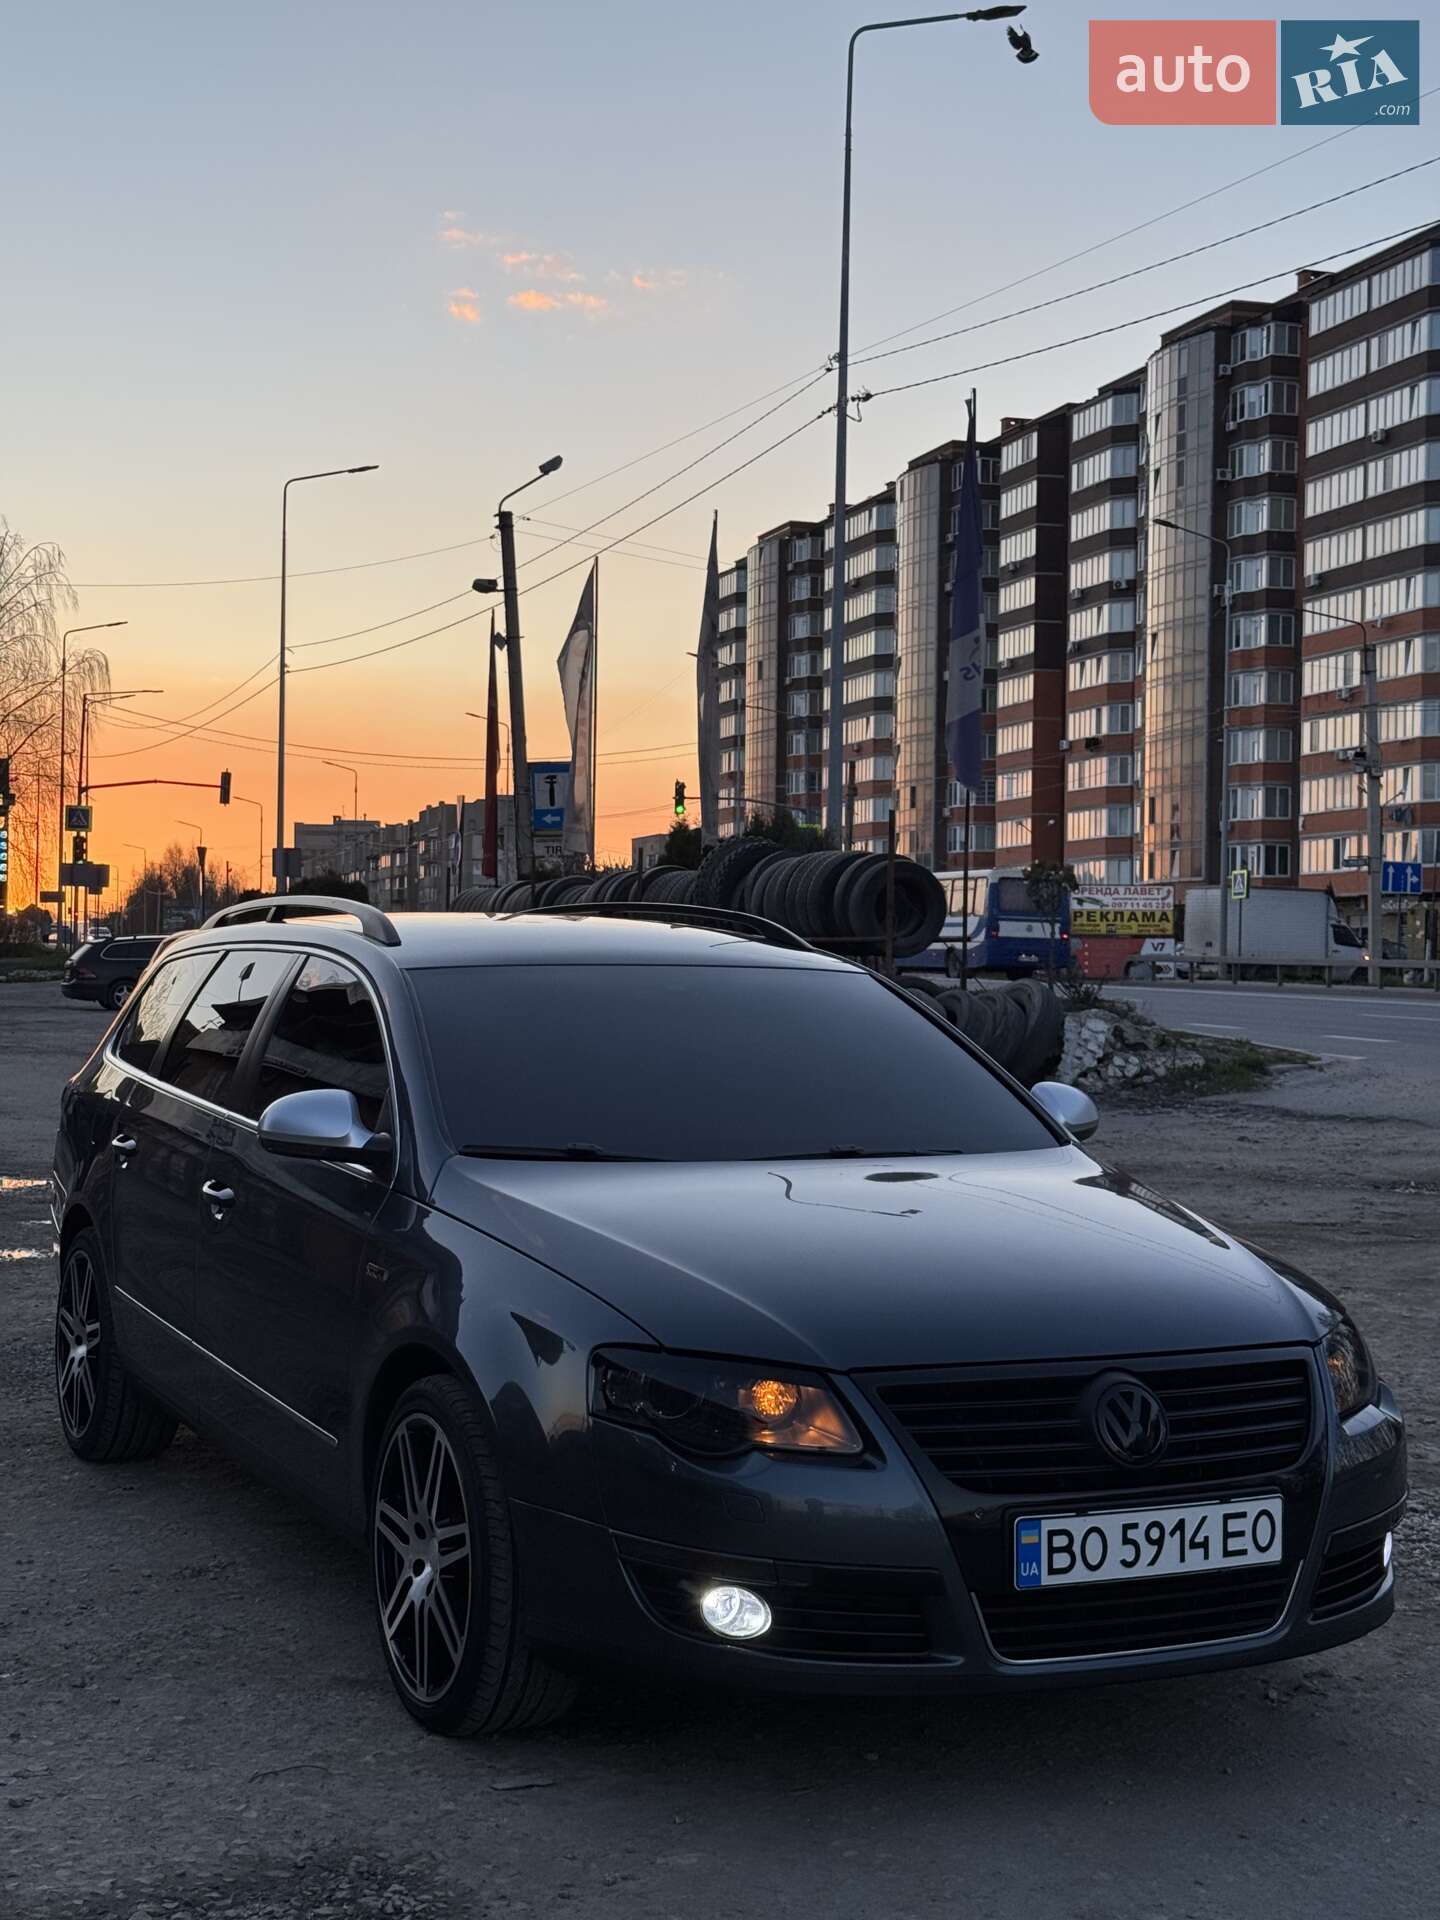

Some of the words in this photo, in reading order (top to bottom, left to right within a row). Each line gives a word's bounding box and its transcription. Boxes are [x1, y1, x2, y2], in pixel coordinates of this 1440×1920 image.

[1123, 887, 1162, 896] ЛАВЕТ
[1073, 910, 1171, 923] РЕКЛАМА
[1020, 1561, 1039, 1577] UA
[1047, 1526, 1109, 1576] BO
[1119, 1514, 1210, 1569] 5914
[1222, 1508, 1277, 1559] EO
